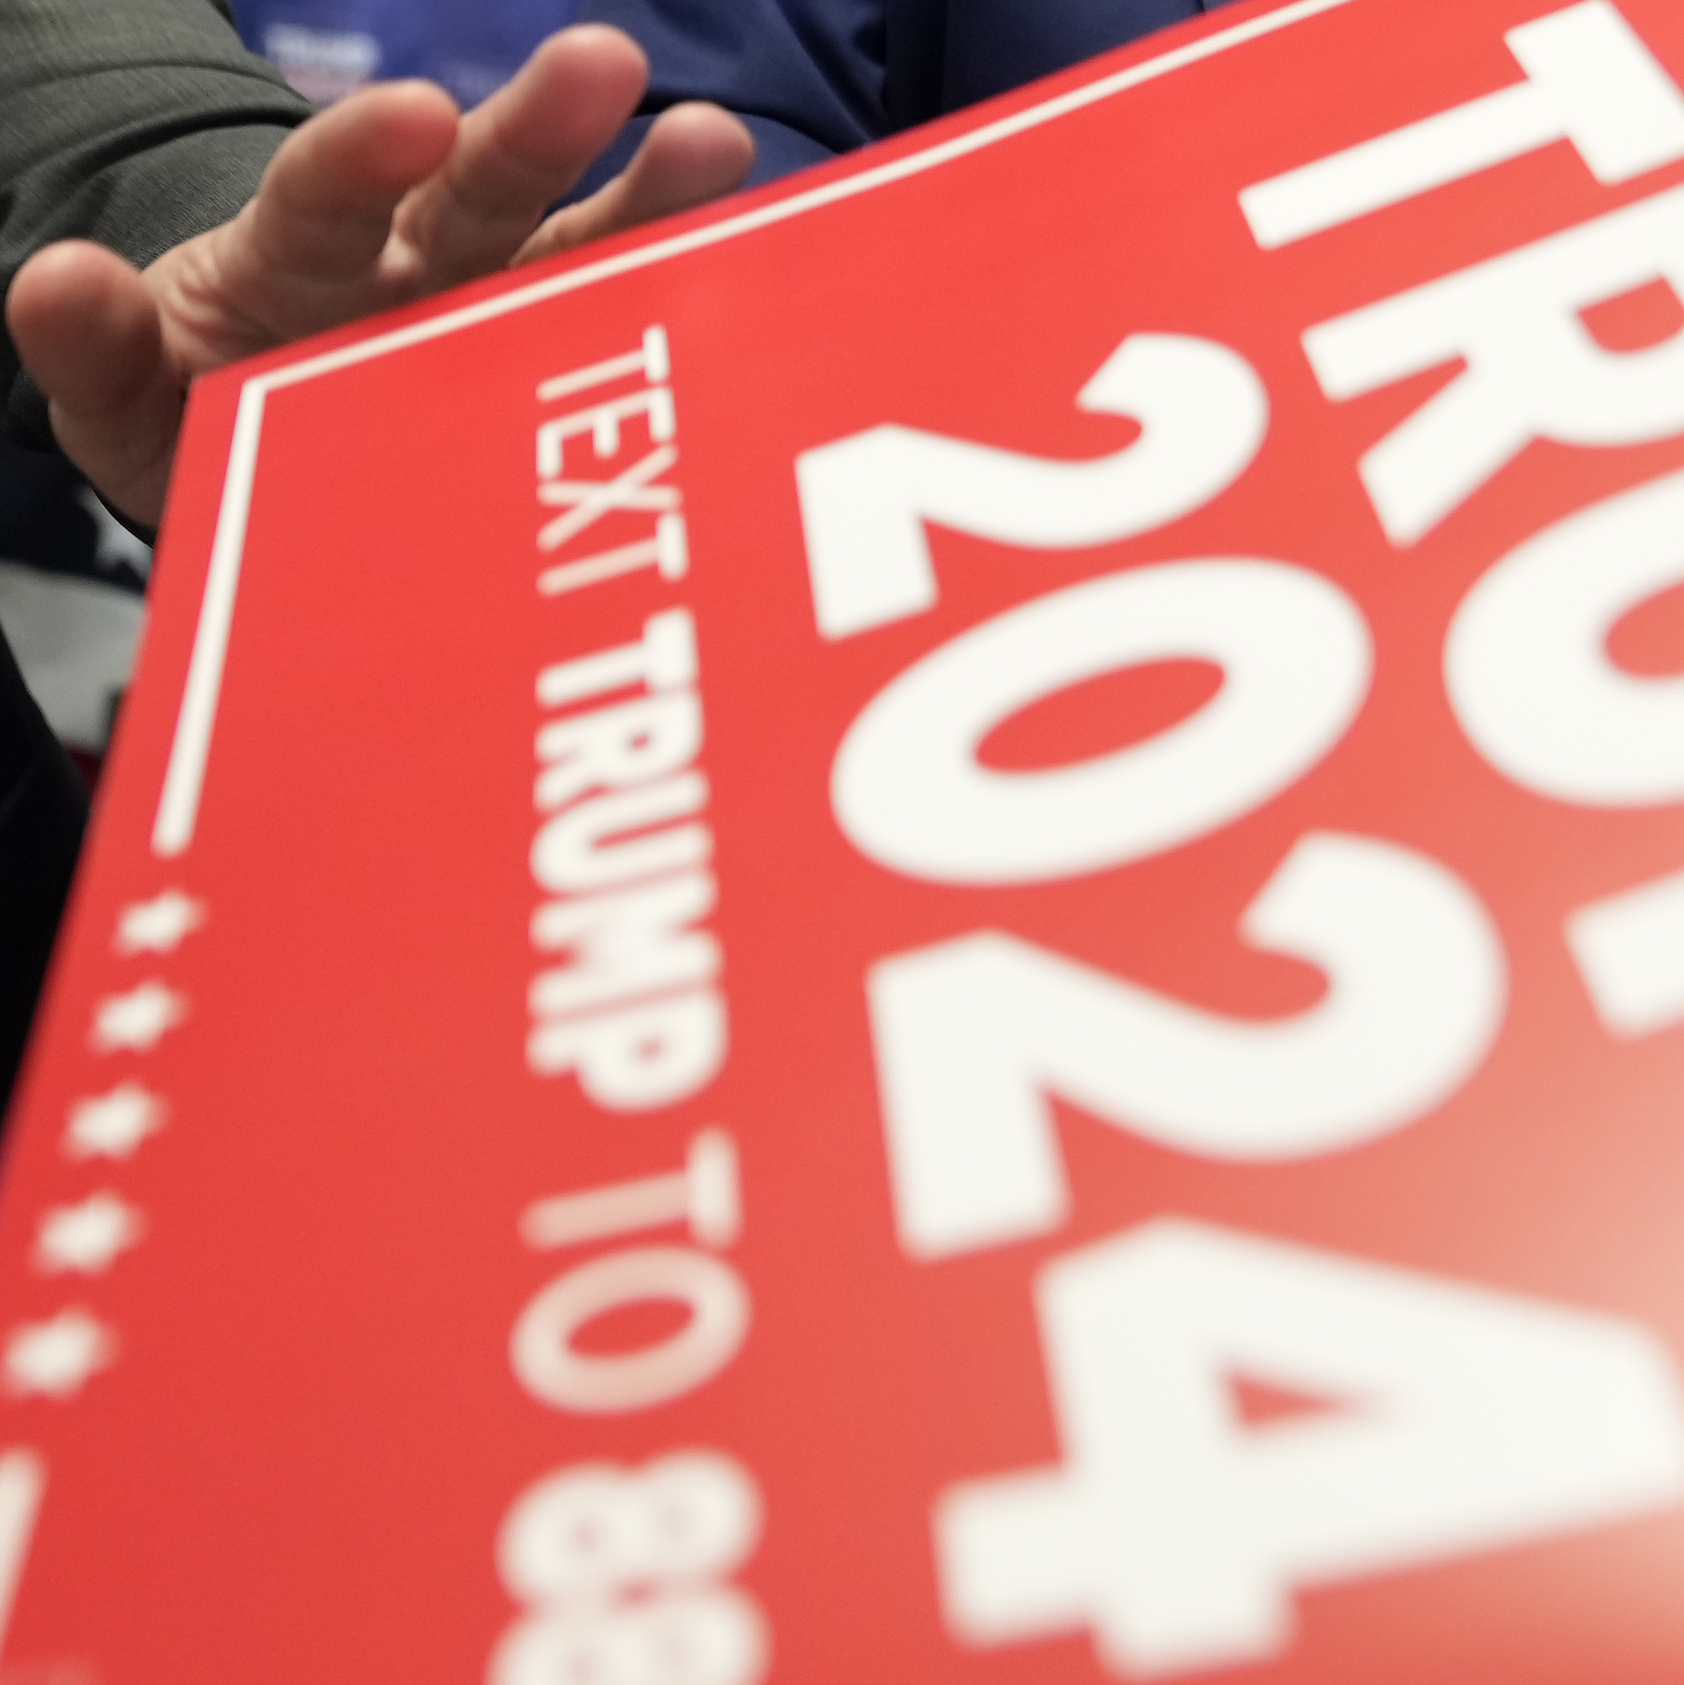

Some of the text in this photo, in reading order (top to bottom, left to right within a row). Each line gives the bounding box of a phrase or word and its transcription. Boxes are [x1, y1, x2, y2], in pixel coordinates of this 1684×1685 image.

[534, 323, 690, 597] TEXT
[525, 606, 731, 1113] TRUMP
[508, 1125, 755, 1416] TO
